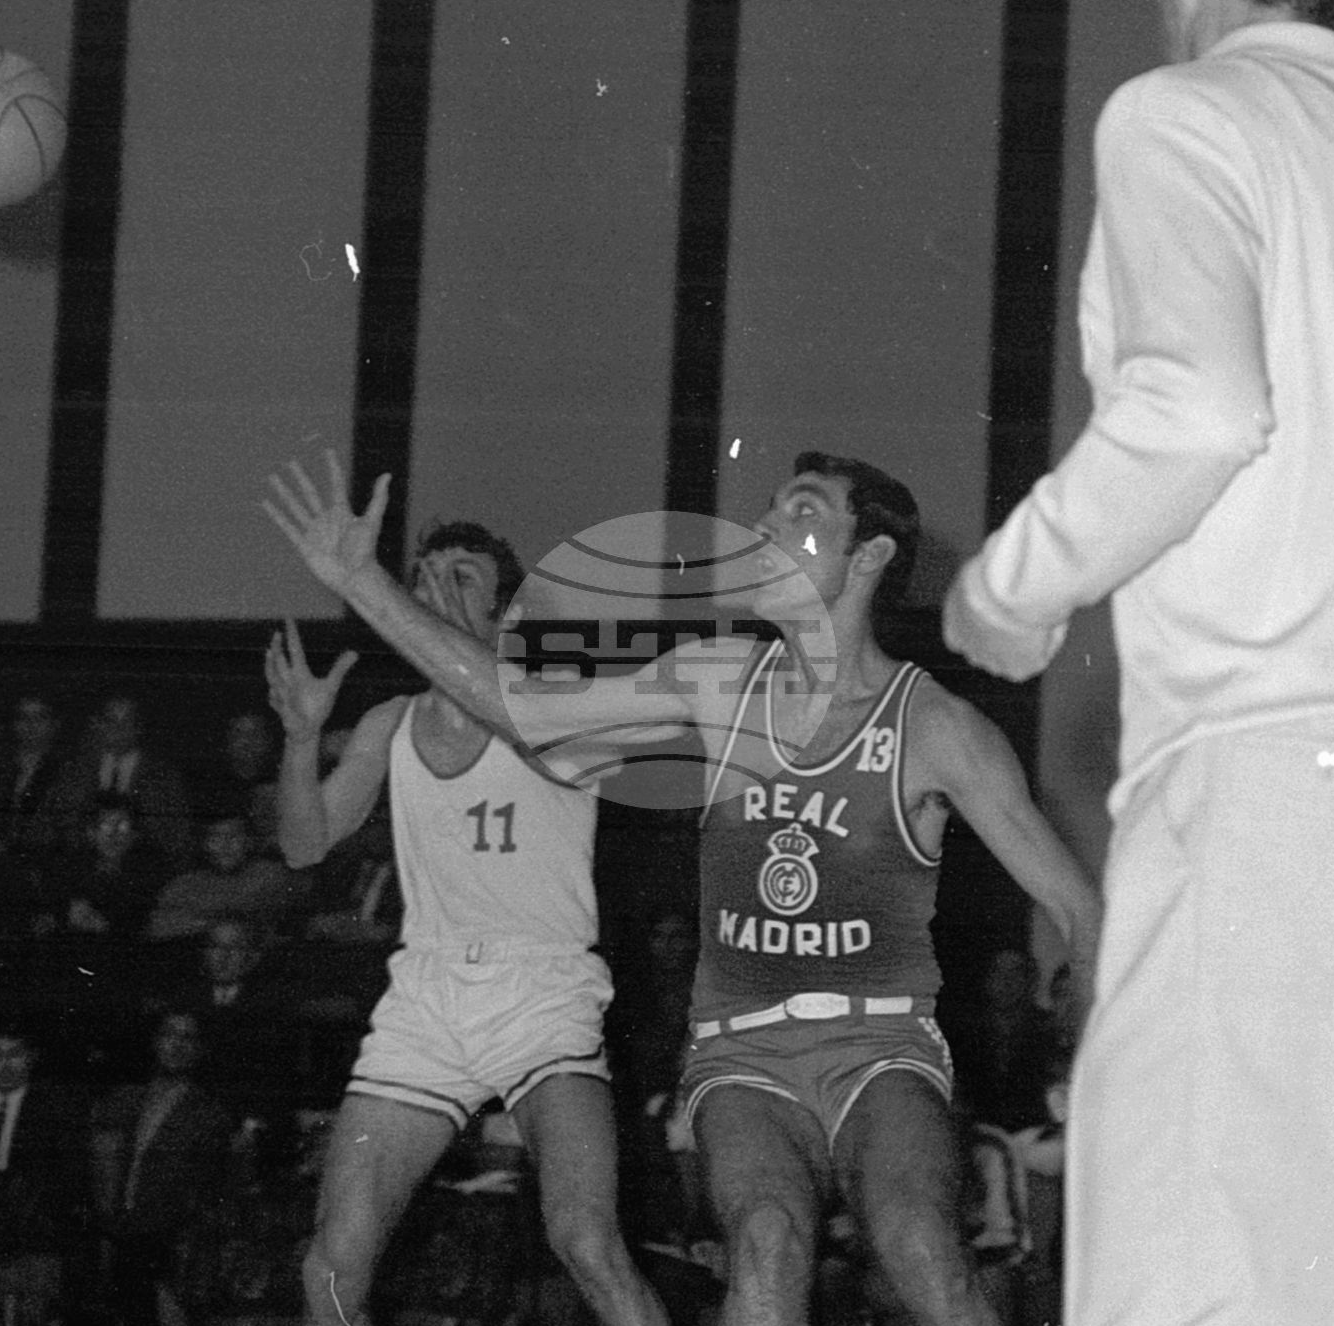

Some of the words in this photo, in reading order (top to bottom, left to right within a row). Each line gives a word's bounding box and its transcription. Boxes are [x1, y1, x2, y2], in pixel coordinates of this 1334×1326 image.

[856, 726, 896, 773] 13
[466, 799, 517, 854] 11
[744, 782, 850, 839] REAL
[719, 908, 872, 958] MADRID
